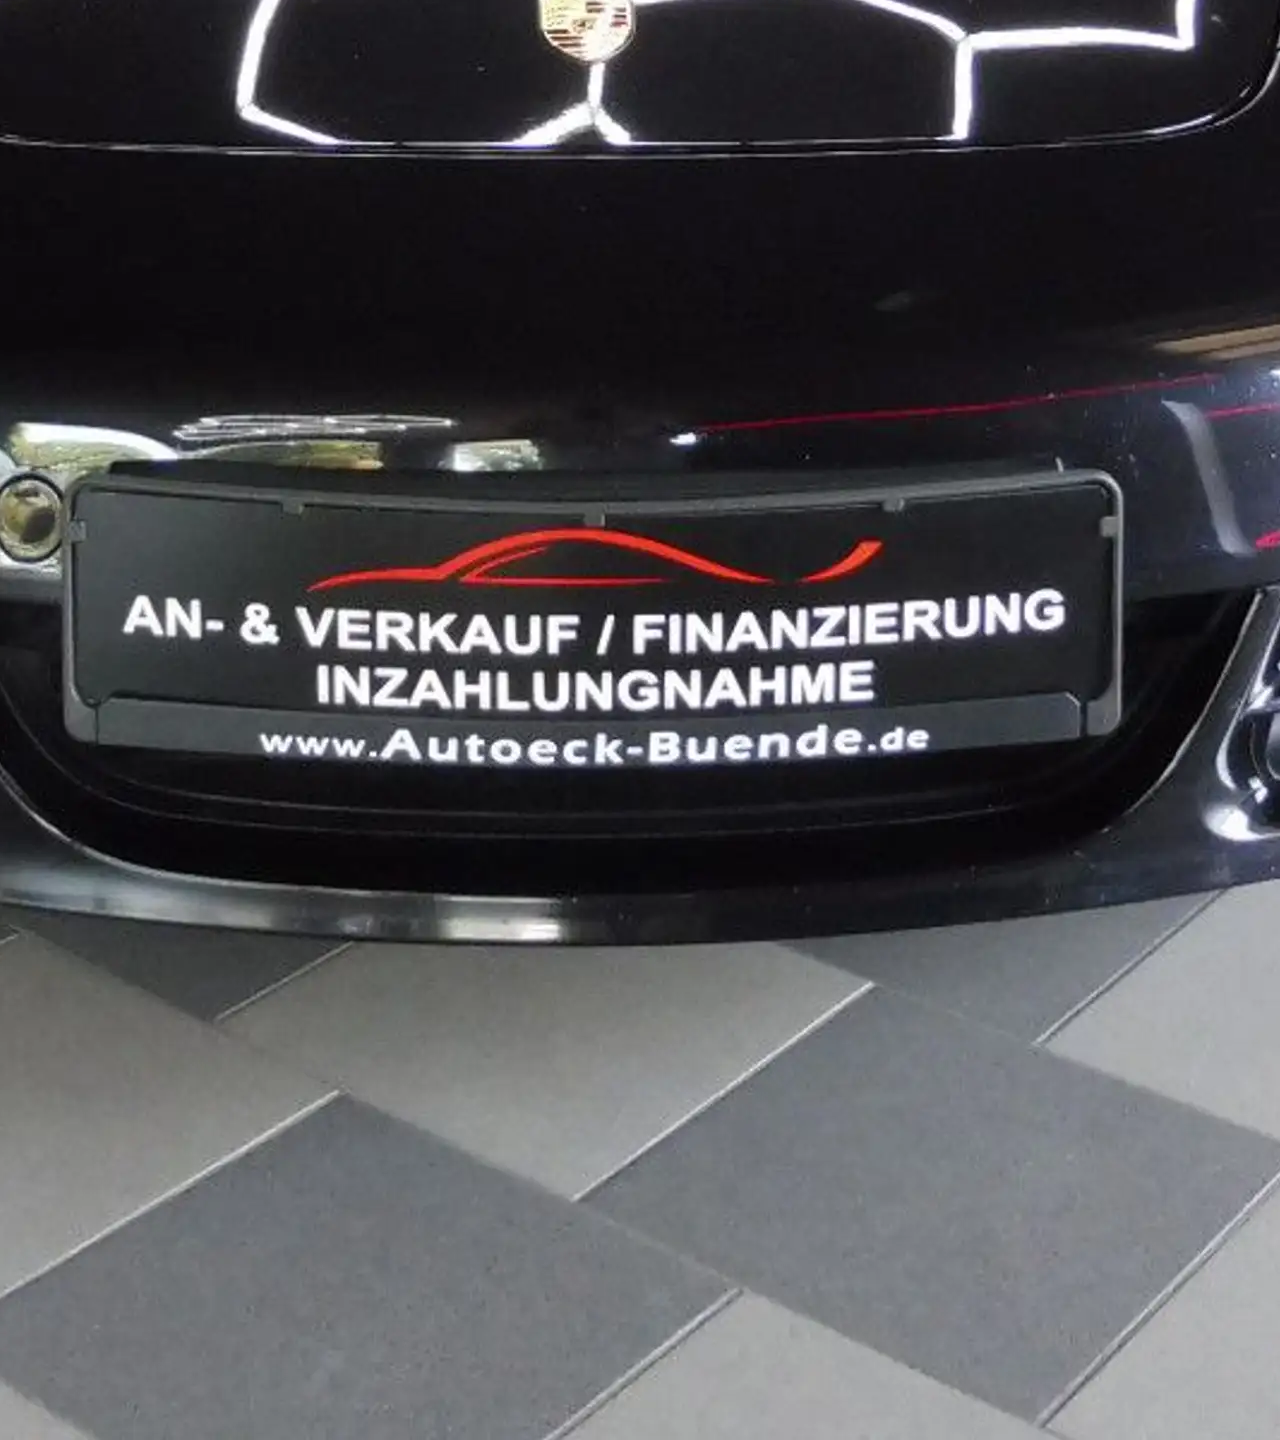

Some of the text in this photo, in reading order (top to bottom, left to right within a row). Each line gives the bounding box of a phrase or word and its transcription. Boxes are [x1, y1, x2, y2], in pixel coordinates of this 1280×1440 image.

[122, 588, 1067, 657] AN- & VERKAUF / FINANZIERUNG
[316, 659, 875, 713] INZAHLUNGNAHME
[258, 723, 930, 767] www.Autoeck-Buende.de
